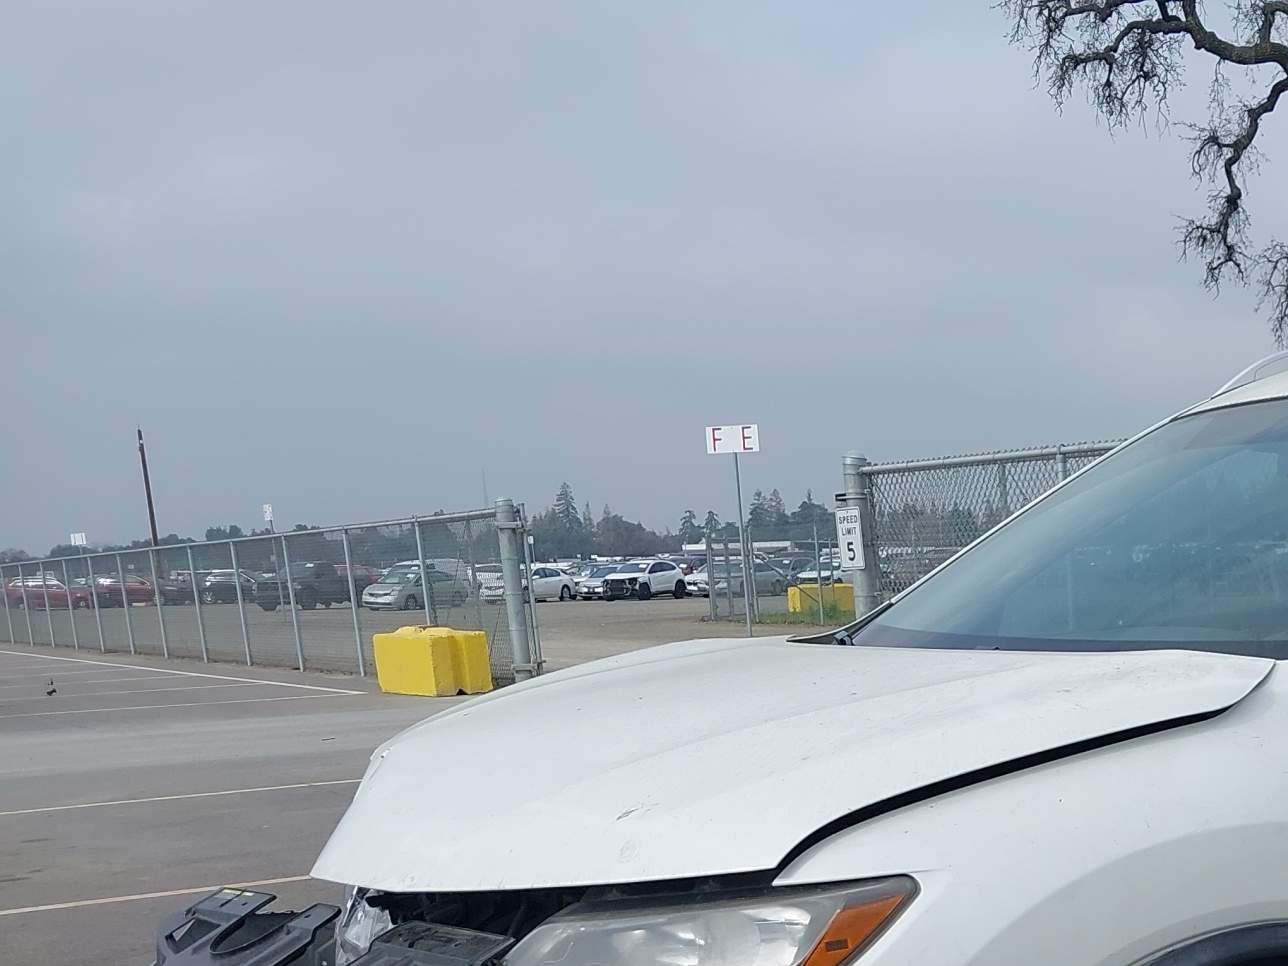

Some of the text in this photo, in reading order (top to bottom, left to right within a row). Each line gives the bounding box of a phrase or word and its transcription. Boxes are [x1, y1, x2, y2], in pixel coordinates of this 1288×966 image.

[712, 426, 753, 452] F E
[838, 515, 858, 525] SPEED
[841, 526, 857, 536] LIMIT
[847, 541, 856, 562] 5
